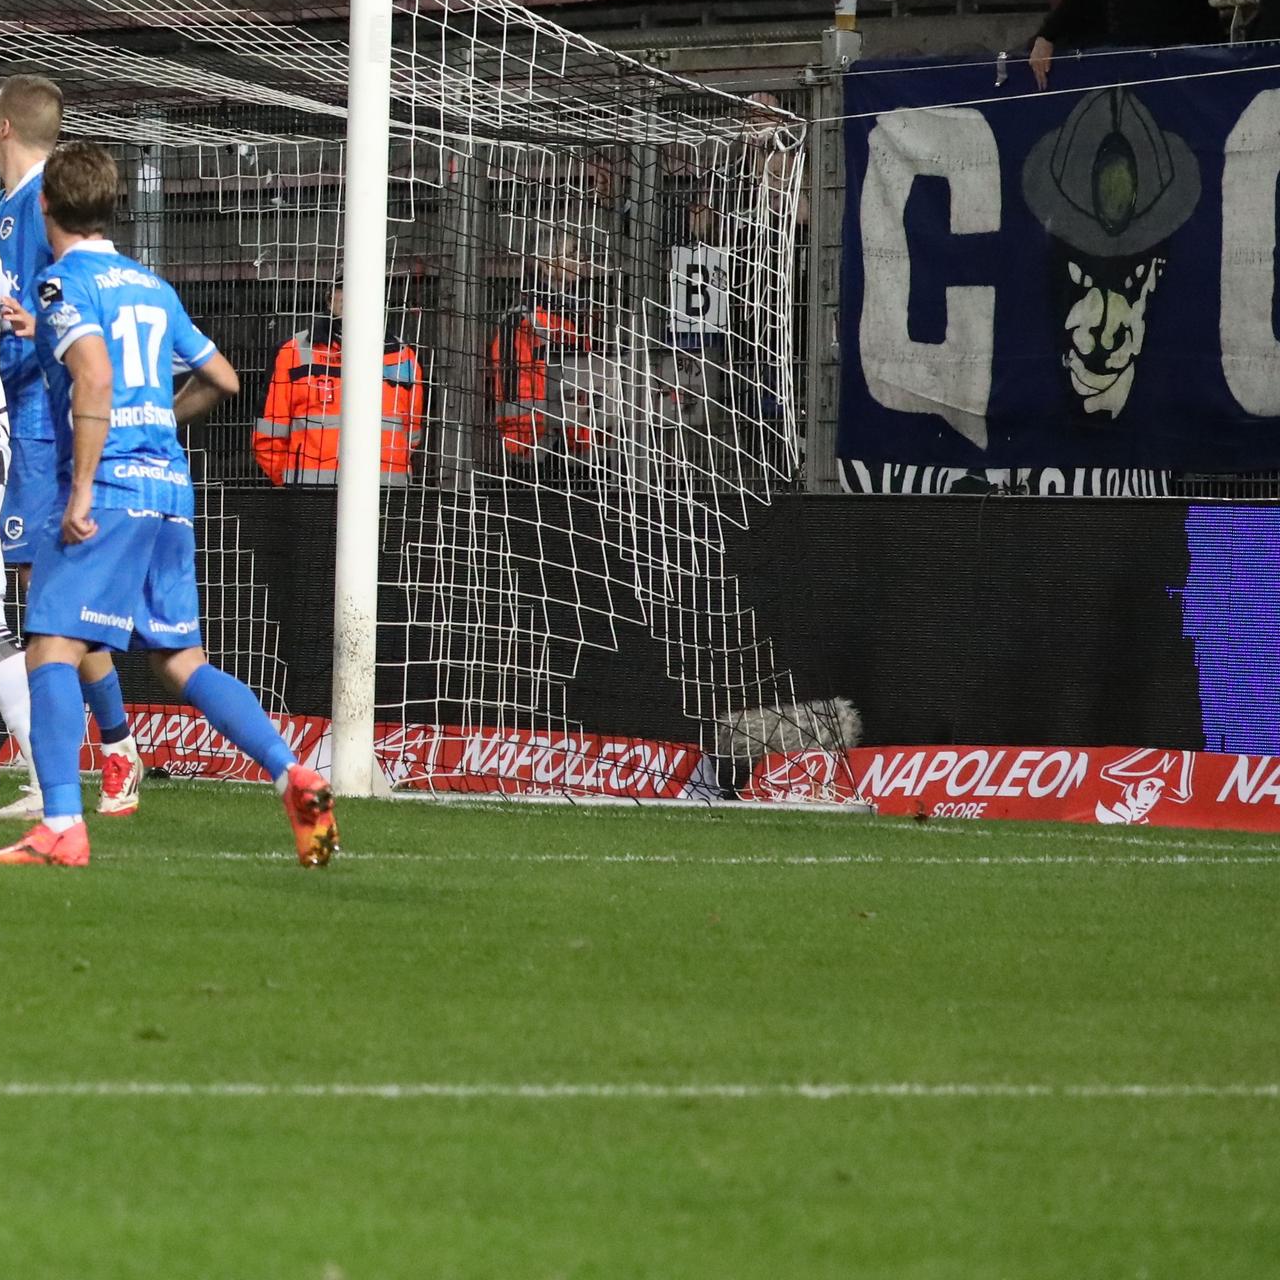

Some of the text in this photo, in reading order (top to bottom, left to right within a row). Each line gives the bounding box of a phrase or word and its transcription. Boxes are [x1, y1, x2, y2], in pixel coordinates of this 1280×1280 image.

[686, 263, 711, 316] B
[111, 303, 168, 388] 17
[113, 464, 189, 487] CARGLASS
[452, 731, 686, 794] NAPOLEON
[857, 749, 1088, 799] NAPOLEON
[931, 801, 989, 821] SCORE
